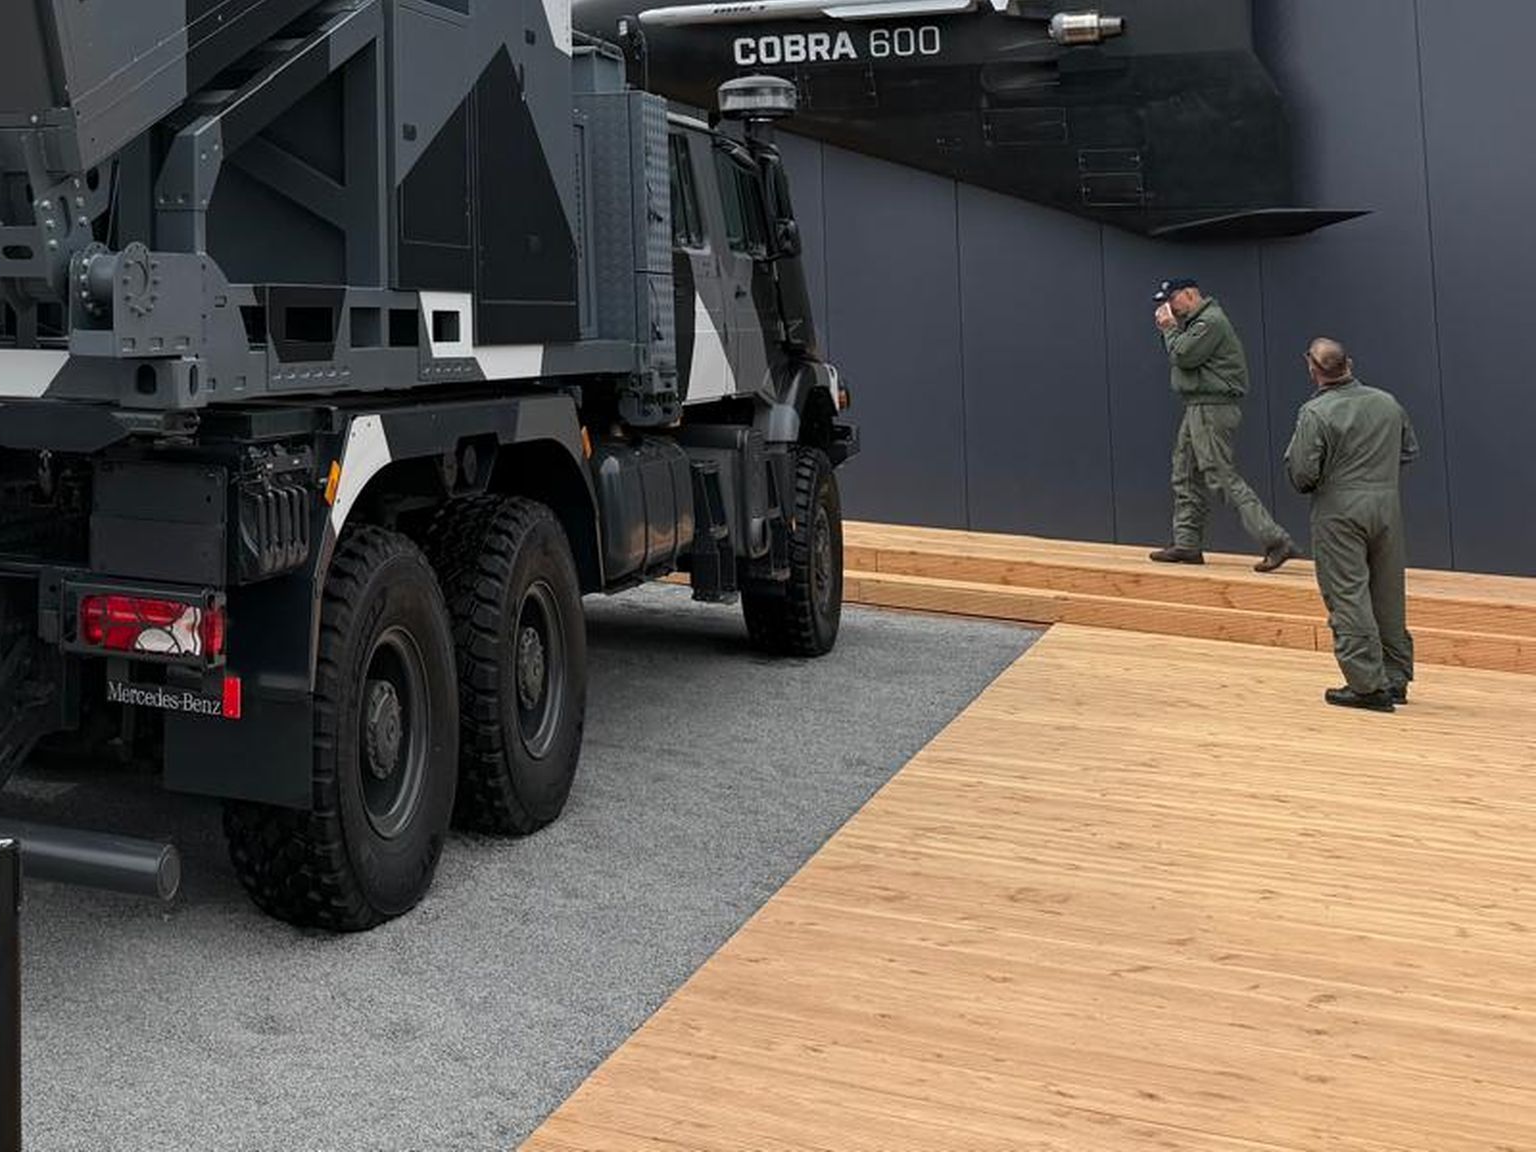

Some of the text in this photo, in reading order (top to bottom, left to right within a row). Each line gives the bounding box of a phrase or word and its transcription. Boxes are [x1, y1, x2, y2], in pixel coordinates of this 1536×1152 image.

[733, 25, 941, 66] COBRA 600
[107, 680, 222, 716] Mercedes-Benz
